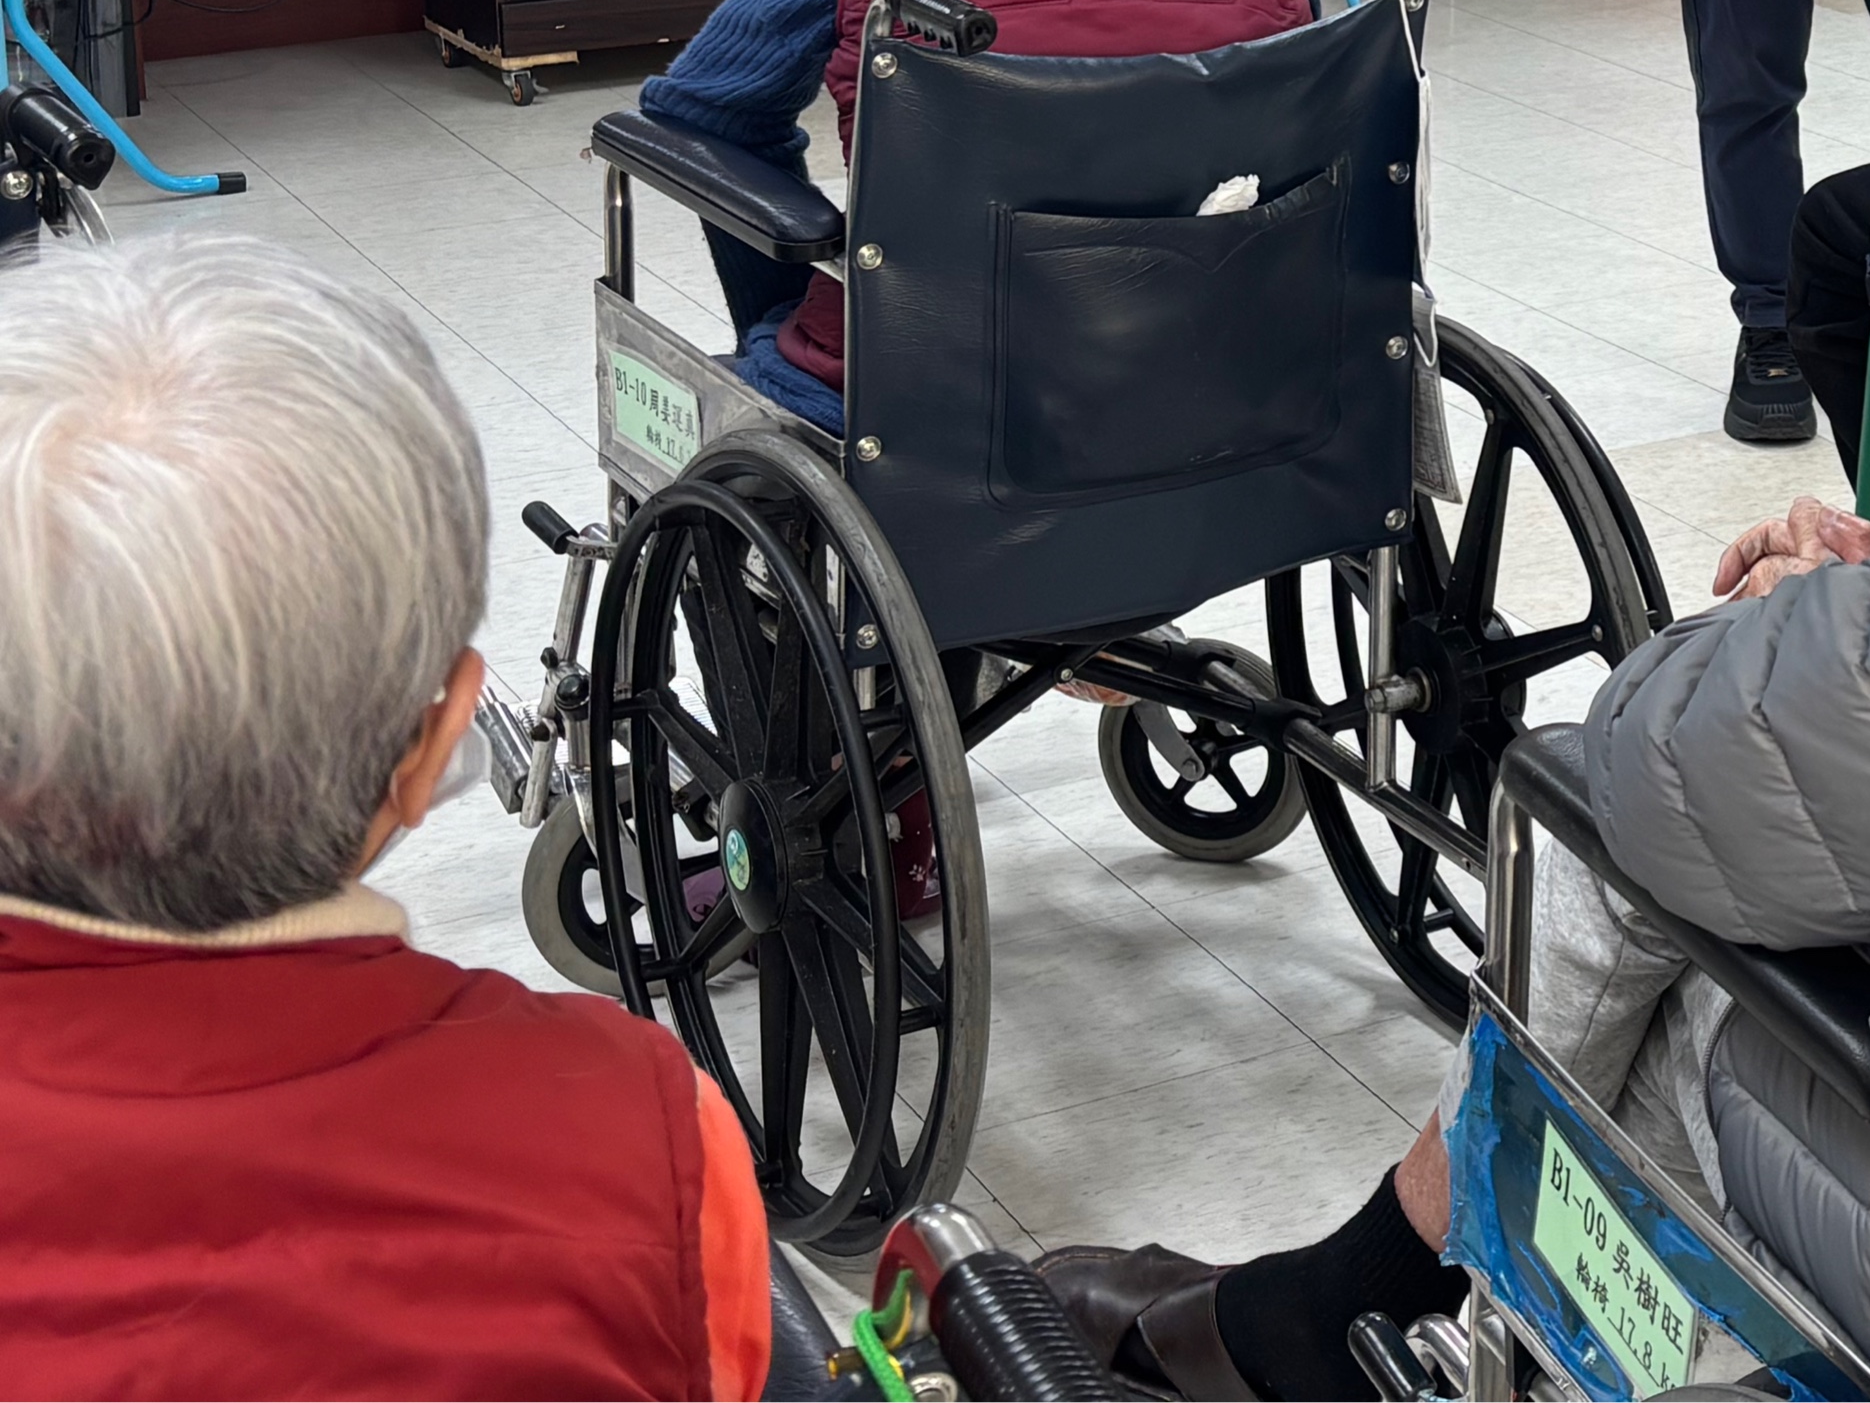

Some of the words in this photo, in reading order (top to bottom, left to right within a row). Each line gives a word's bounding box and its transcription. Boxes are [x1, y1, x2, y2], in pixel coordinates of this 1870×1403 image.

[615, 367, 647, 407] B1-10
[1551, 1148, 1607, 1251] B1-09
[1613, 1240, 1684, 1355] 吳樹旺
[1575, 1252, 1610, 1314] 輪椅
